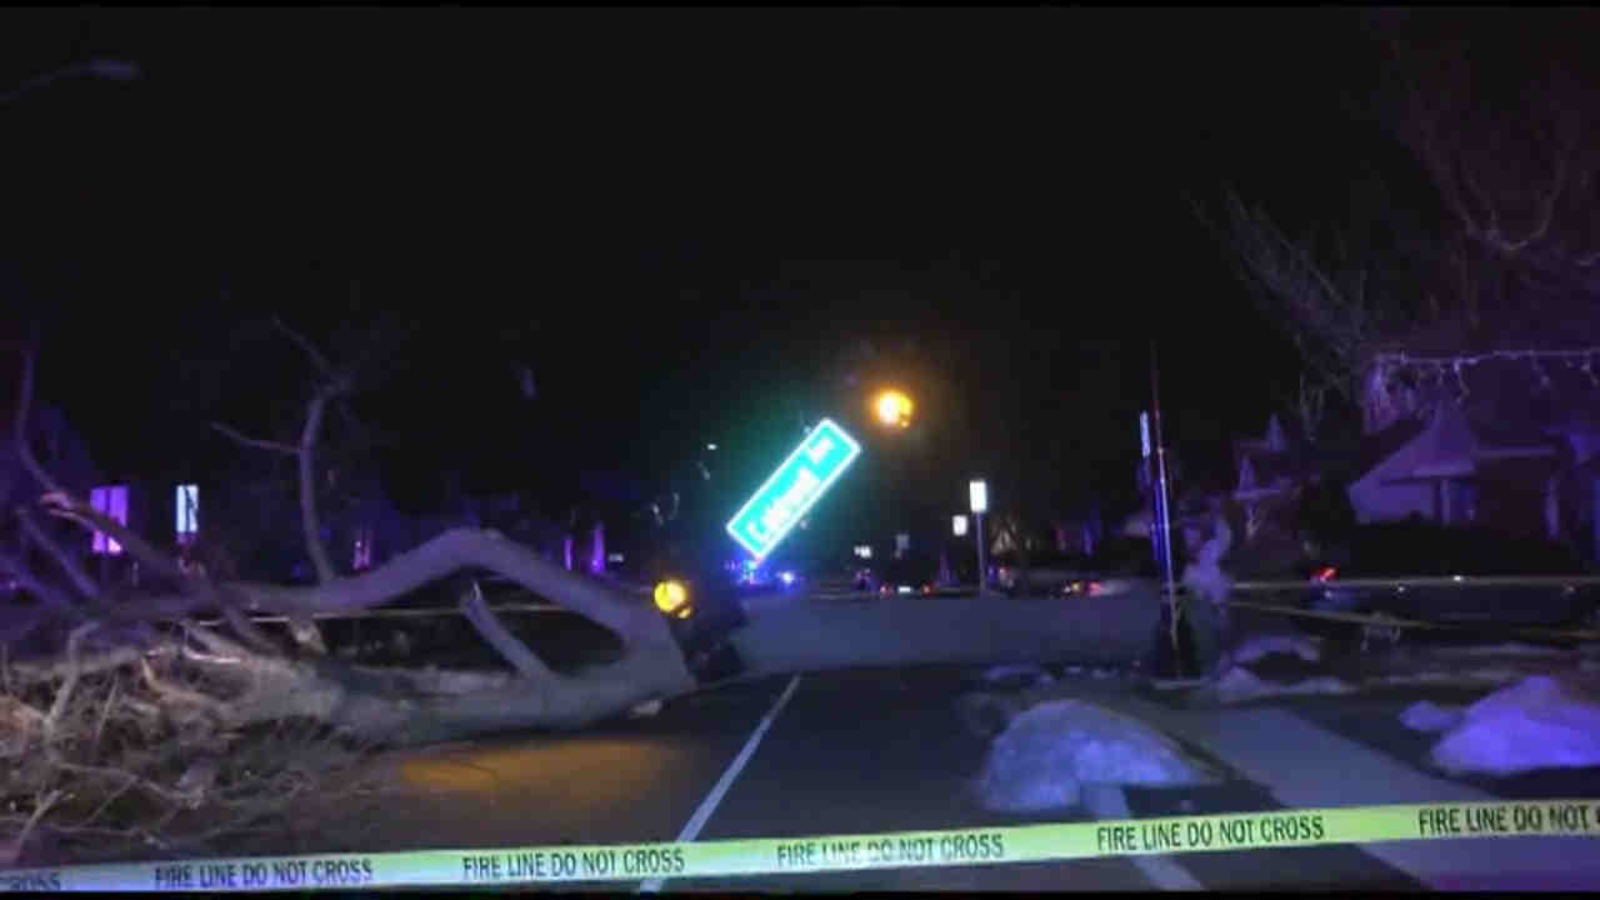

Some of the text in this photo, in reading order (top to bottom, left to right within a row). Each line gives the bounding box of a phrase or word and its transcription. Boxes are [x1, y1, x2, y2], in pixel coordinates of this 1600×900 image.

[1097, 815, 1325, 851] FIRE LINE DO NOT CROSS
[1418, 807, 1461, 835] FIRE
[1465, 805, 1508, 833] LINE
[1513, 804, 1543, 832] DO
[1549, 804, 1591, 831] NOT
[463, 847, 686, 879] FIRE LINE DO NOT CROSS
[777, 842, 815, 866] FIRE
[867, 838, 893, 862] DO
[899, 837, 935, 861] NOT
[940, 833, 1005, 859] CROSS
[200, 863, 237, 888] LINE
[243, 862, 268, 886] DO
[273, 860, 307, 884] NOT
[312, 857, 373, 882] CROSS
